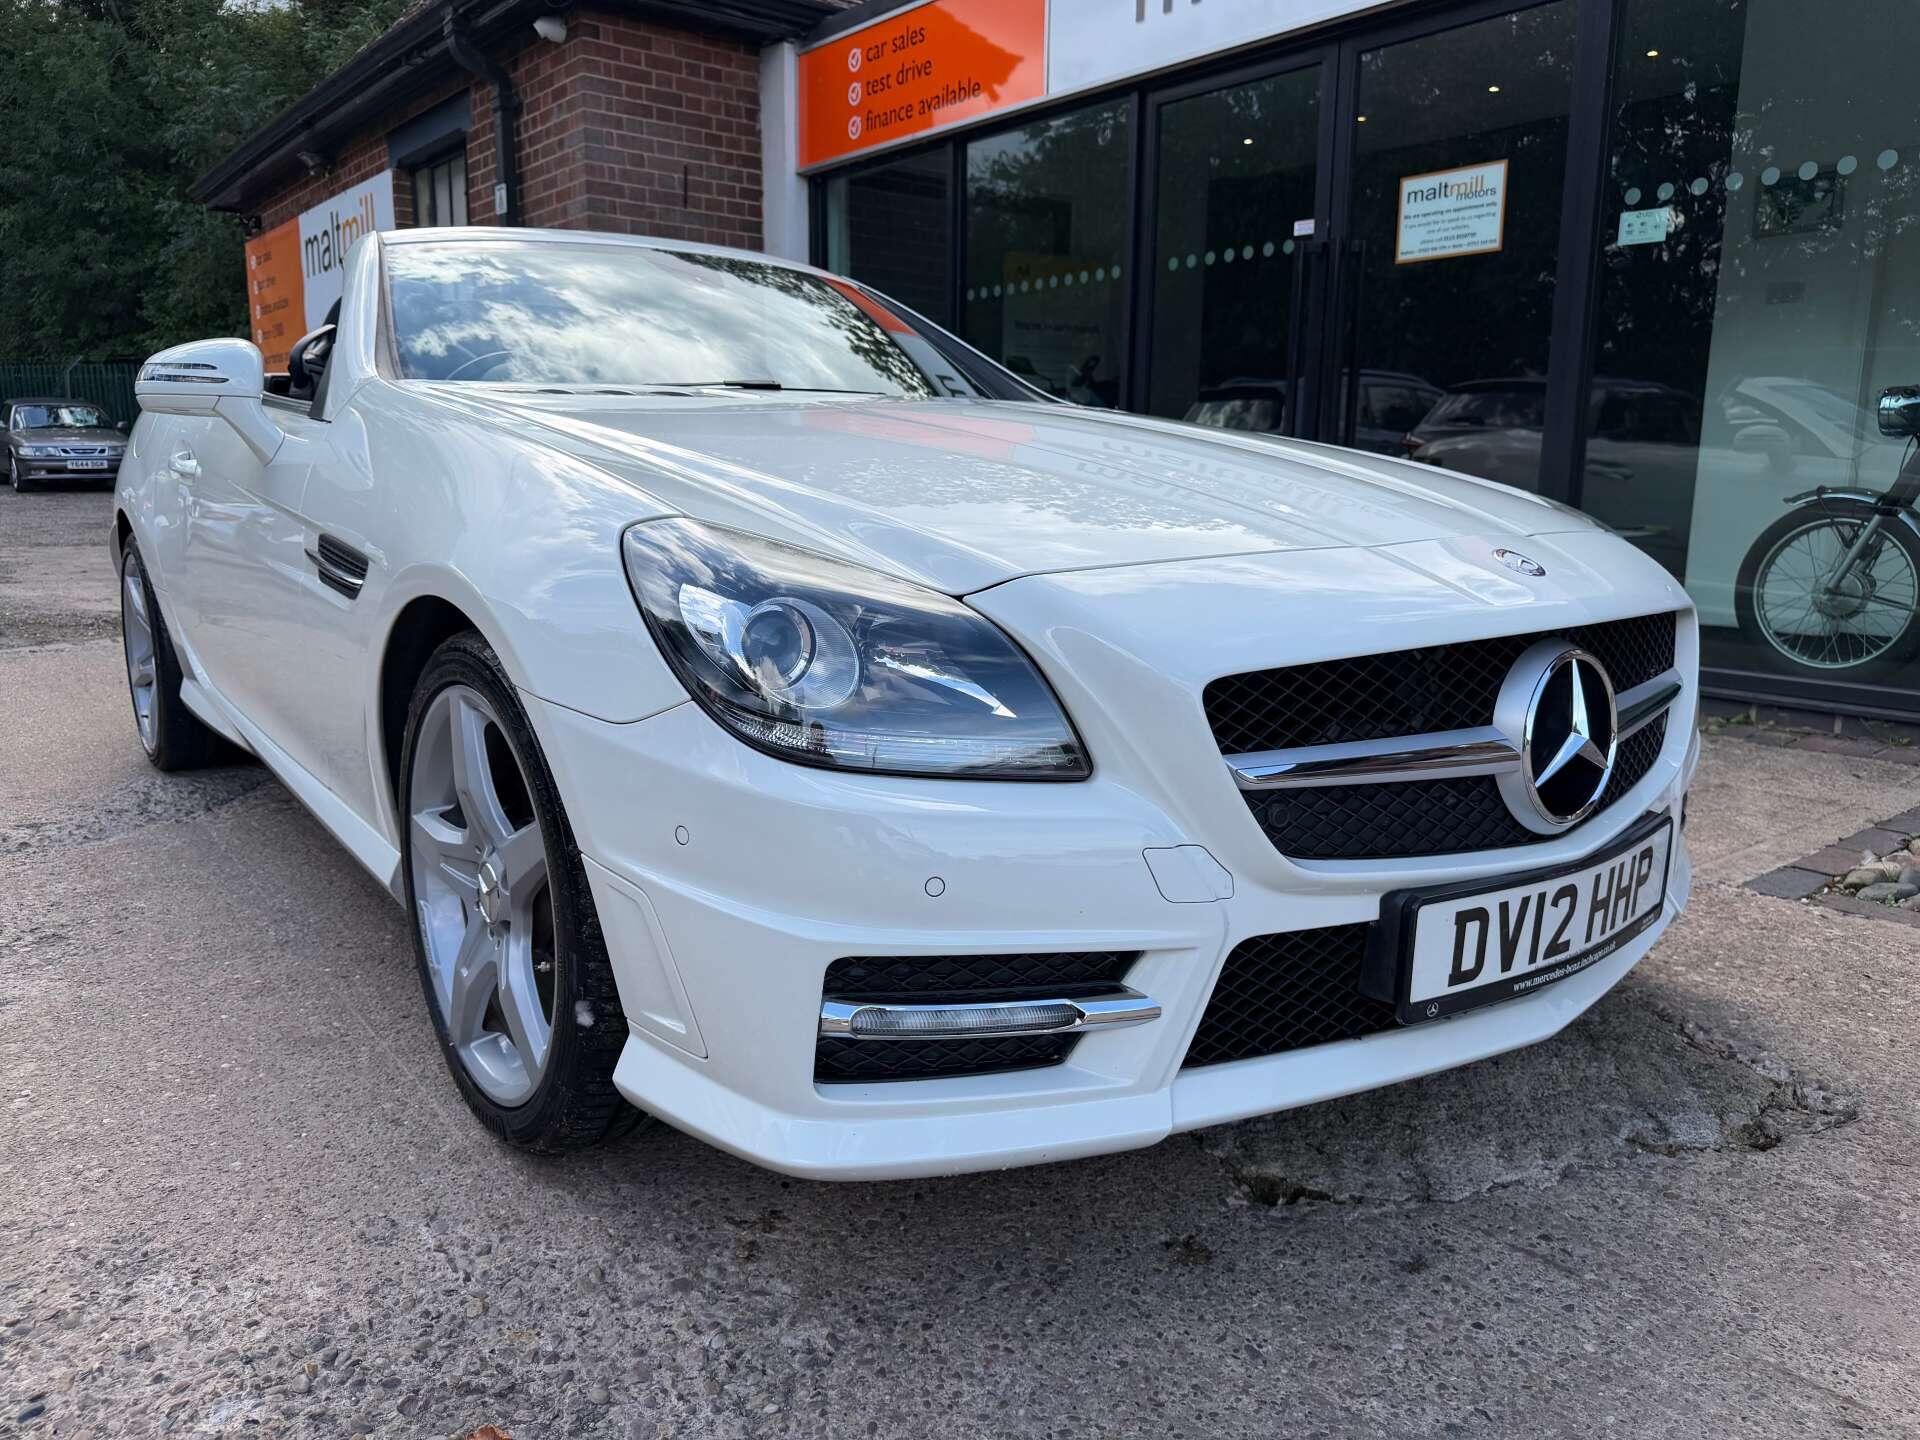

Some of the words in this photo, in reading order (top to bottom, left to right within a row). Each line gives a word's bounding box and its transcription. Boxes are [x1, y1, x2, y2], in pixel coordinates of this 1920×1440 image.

[866, 40, 887, 62] car
[892, 25, 926, 53] sales
[866, 73, 892, 96] test
[896, 59, 933, 86] drive
[866, 103, 913, 131] finance
[918, 76, 981, 116] available
[1407, 175, 1485, 205] maltmill
[1456, 187, 1497, 201] motors
[304, 192, 375, 279] maltmill
[1447, 883, 1579, 988] DV12
[1584, 846, 1654, 945] HHP
